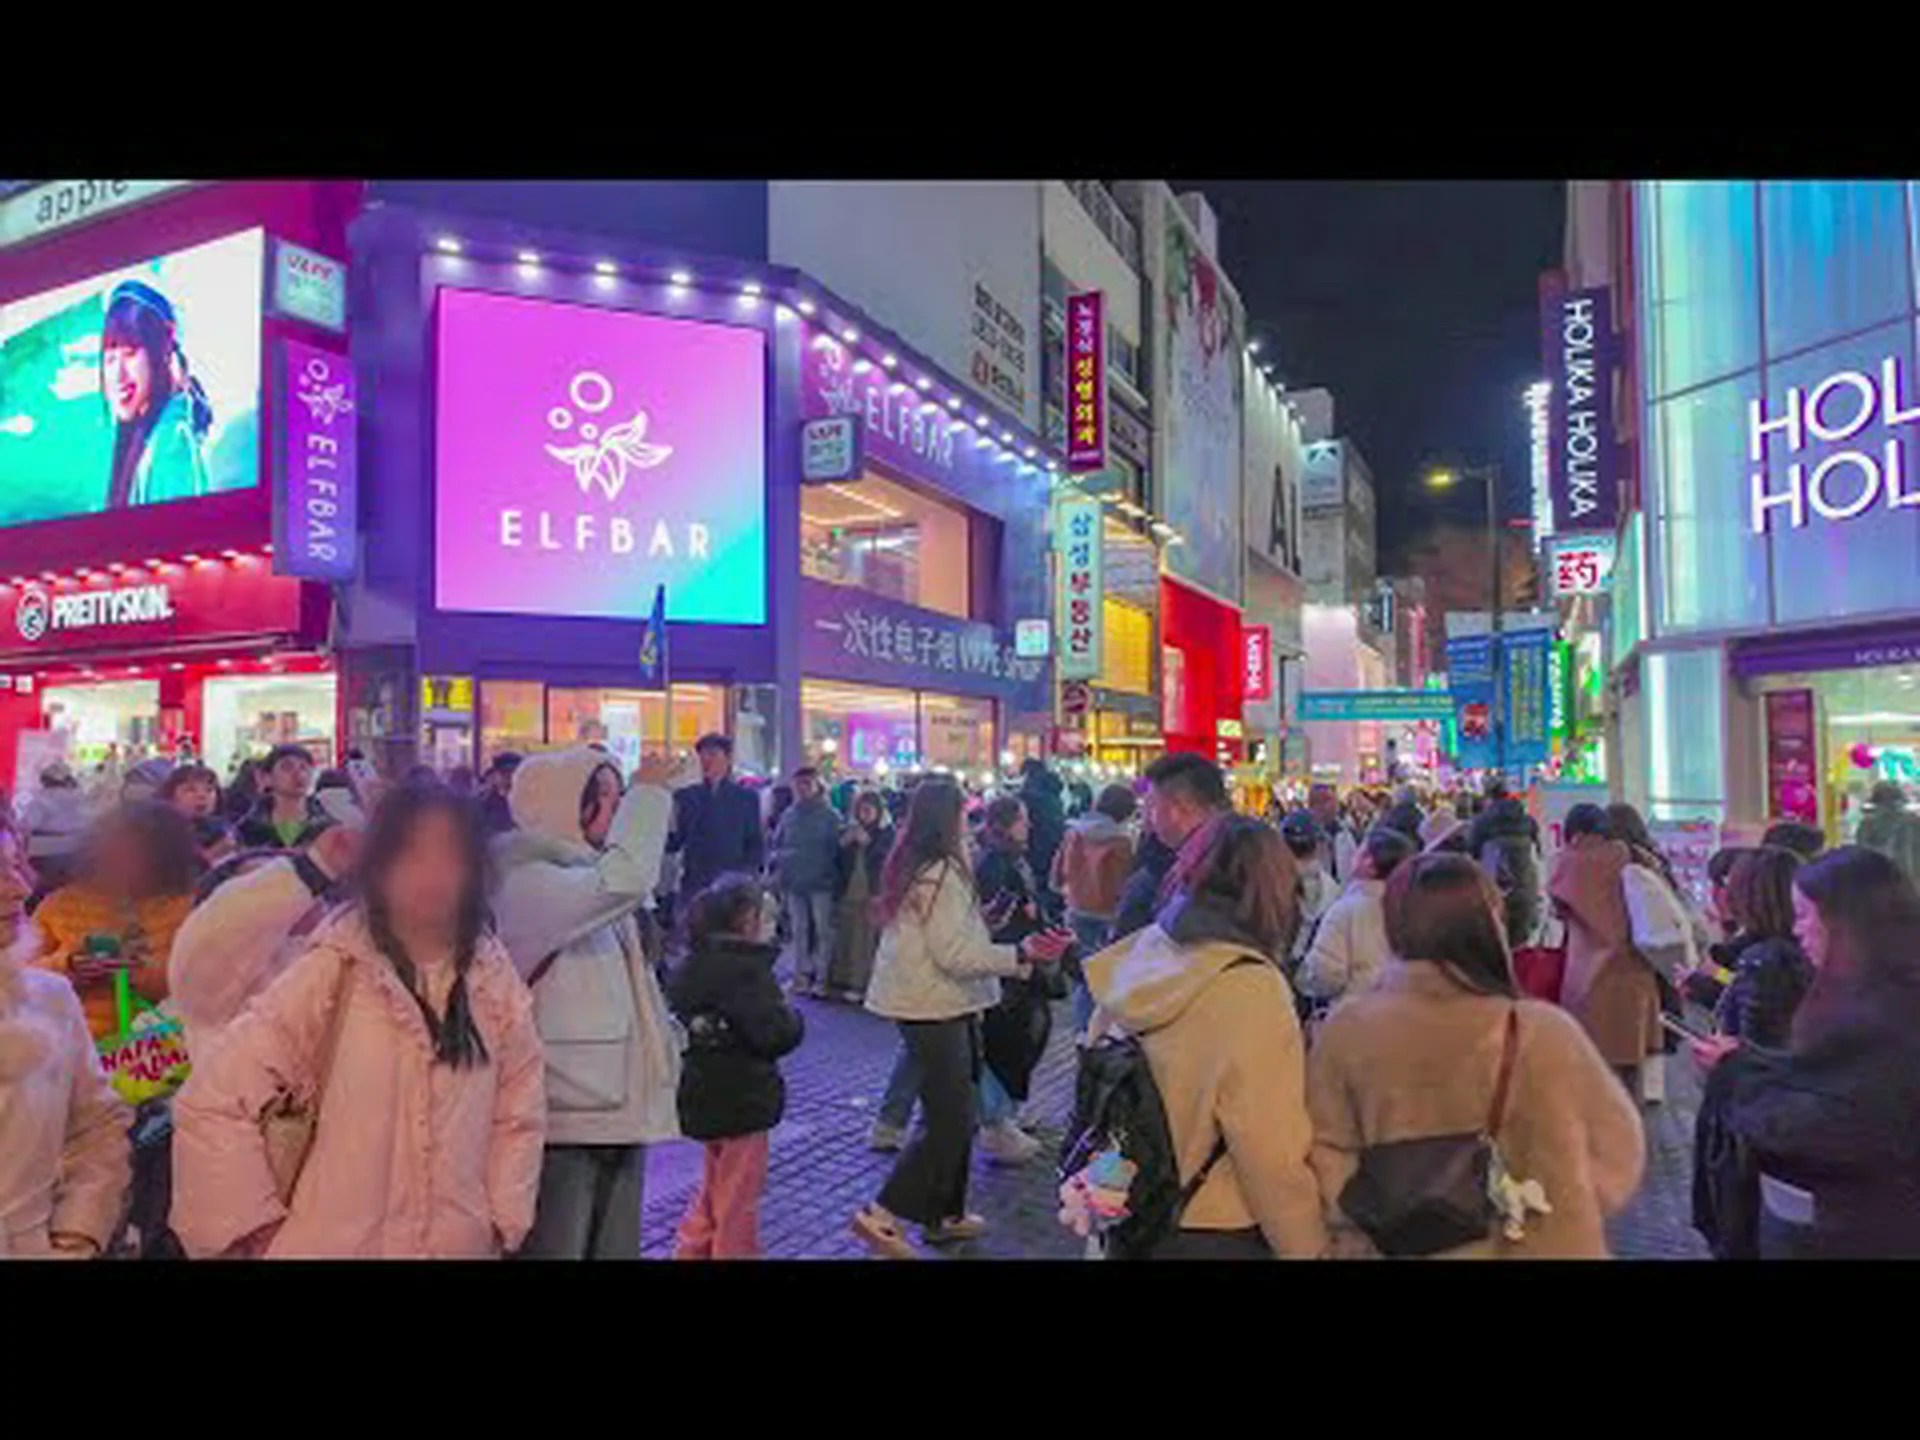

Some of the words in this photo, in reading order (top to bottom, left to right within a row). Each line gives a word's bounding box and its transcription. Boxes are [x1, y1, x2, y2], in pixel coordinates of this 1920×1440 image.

[1563, 299, 1598, 403] HOLIKA
[865, 387, 955, 468] ELFBAR
[1566, 411, 1600, 517] HOLIKA
[306, 434, 338, 561] ELFBAR
[500, 510, 711, 560] ELFBAR
